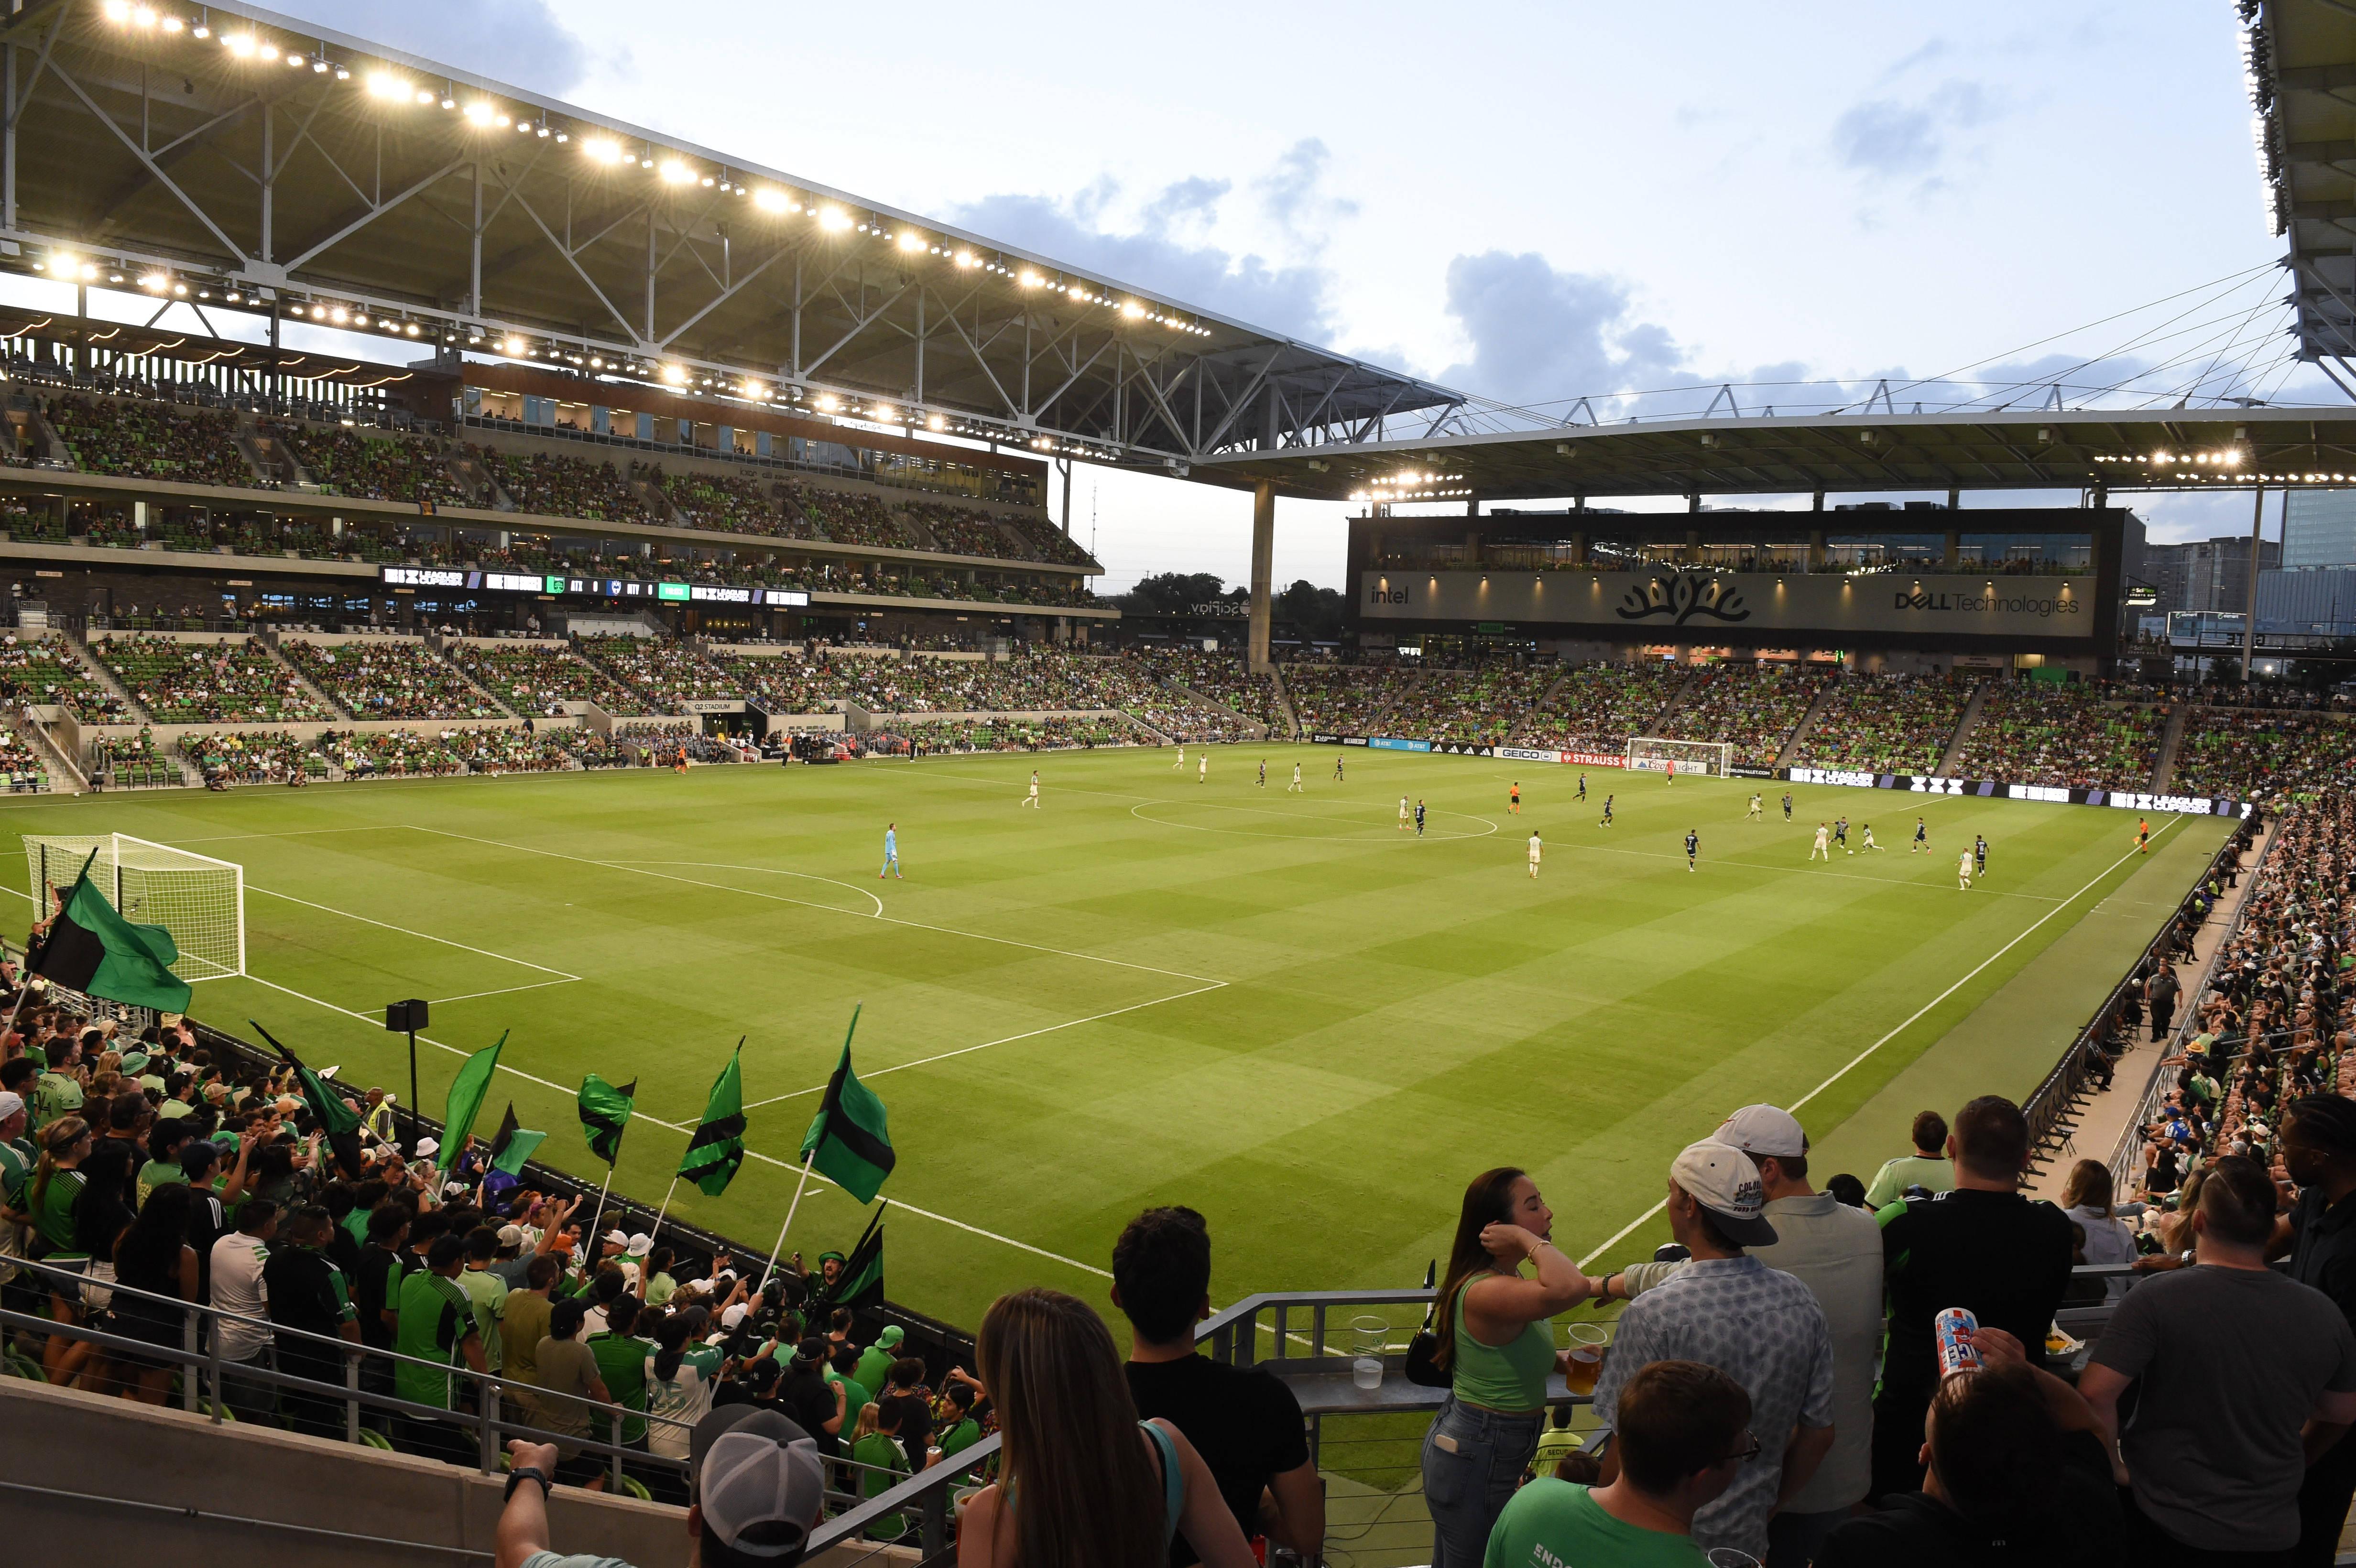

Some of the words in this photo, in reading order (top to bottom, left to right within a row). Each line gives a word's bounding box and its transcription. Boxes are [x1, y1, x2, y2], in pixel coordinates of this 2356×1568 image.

[419, 570, 463, 580] LEAGUES
[571, 580, 583, 591] ATX
[627, 584, 640, 595] MTY
[717, 588, 749, 597] LEAGUES
[1371, 586, 1409, 604] intel
[1895, 592, 1951, 611] DELL
[1952, 593, 2078, 617] Technologies
[1503, 749, 1539, 759] GEICO
[1573, 755, 1619, 765] STRAUSS
[1648, 760, 1667, 769] Coo
[1826, 771, 1874, 781] LEAGUES
[2153, 795, 2211, 806] LEAGUES
[2153, 803, 2179, 811] CUP
[2178, 805, 2211, 814] 2024
[1942, 1341, 1981, 1368] ICEE
[1533, 1543, 1573, 1568] END
